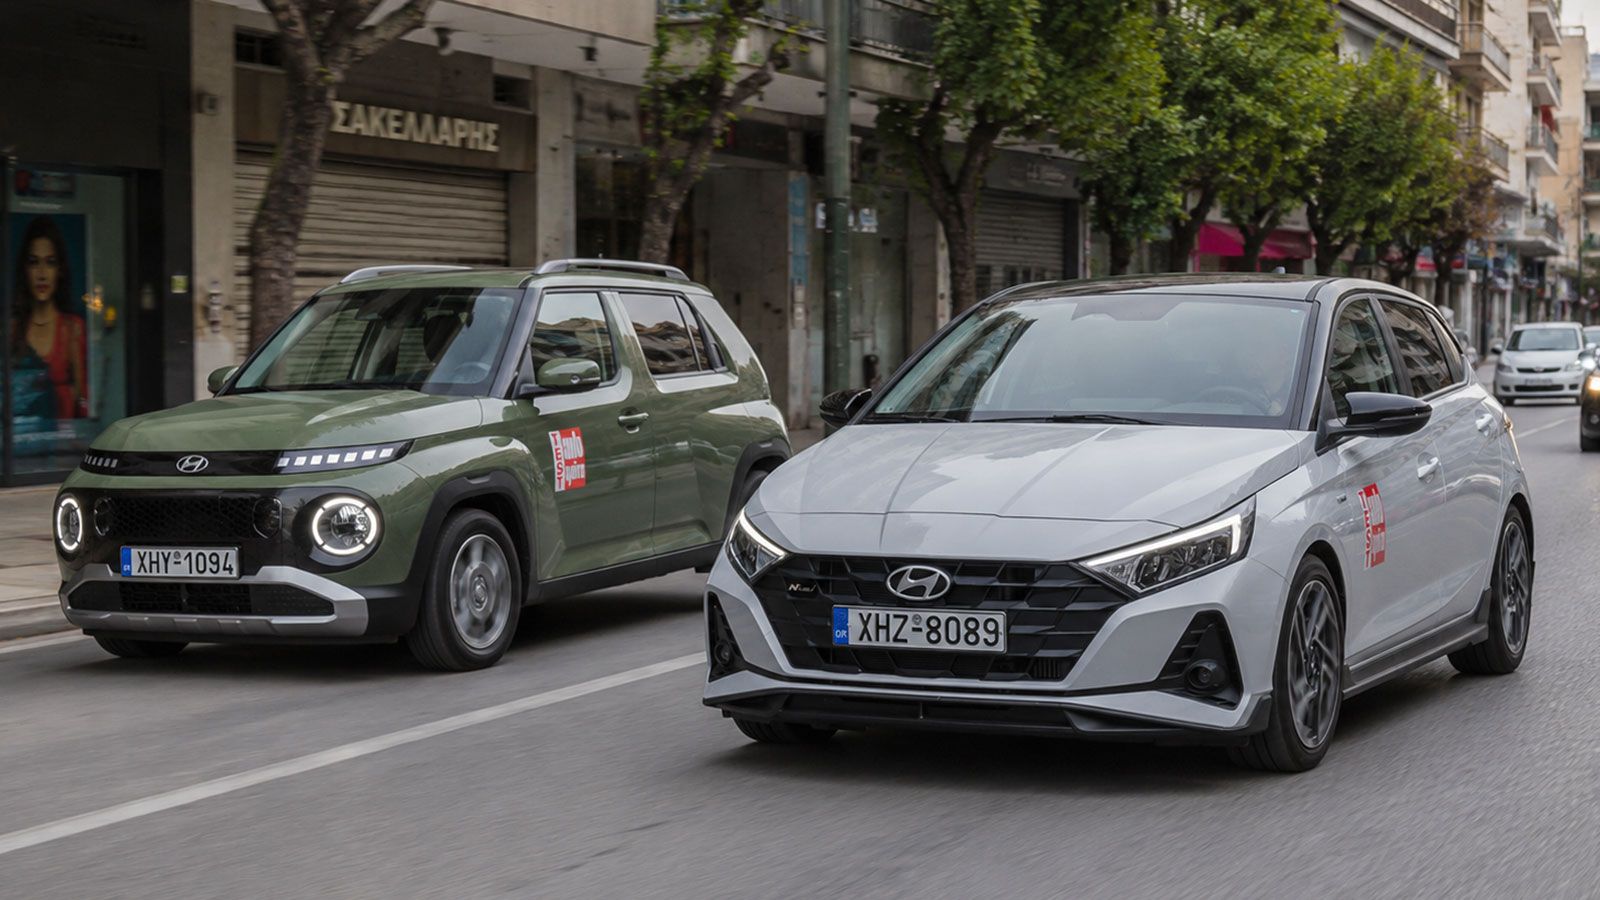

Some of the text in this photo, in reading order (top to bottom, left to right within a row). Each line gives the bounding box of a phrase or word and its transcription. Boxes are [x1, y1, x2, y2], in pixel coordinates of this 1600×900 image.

[330, 100, 500, 152] ΣΑΚΕΛΛΑΡΗΣ
[550, 432, 564, 490] TEST
[858, 612, 1000, 648] XHZ-8089
